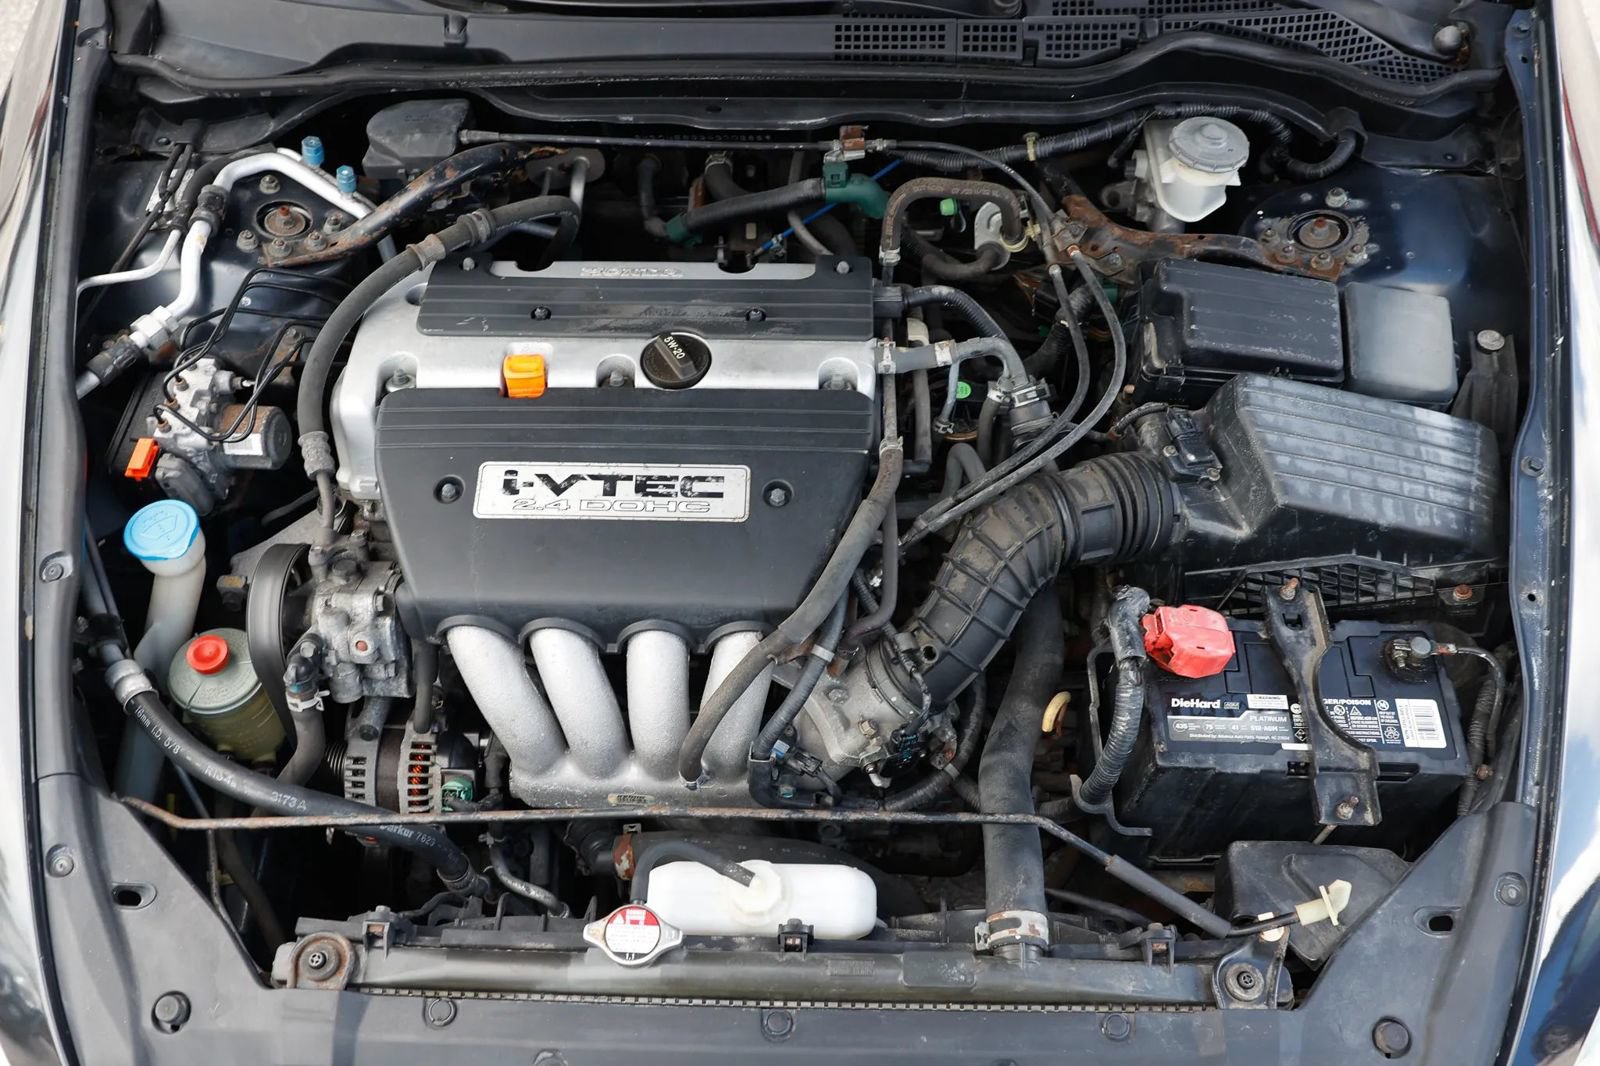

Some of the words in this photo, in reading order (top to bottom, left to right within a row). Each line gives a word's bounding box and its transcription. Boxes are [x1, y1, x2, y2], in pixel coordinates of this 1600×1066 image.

[663, 335, 686, 360] 5W-20
[502, 469, 725, 499] i-VTEC
[512, 498, 571, 511] 2.4
[579, 499, 711, 513] DOHC
[1171, 697, 1221, 709] DieHard
[1249, 715, 1288, 723] PLATINUM
[379, 824, 415, 838] arker
